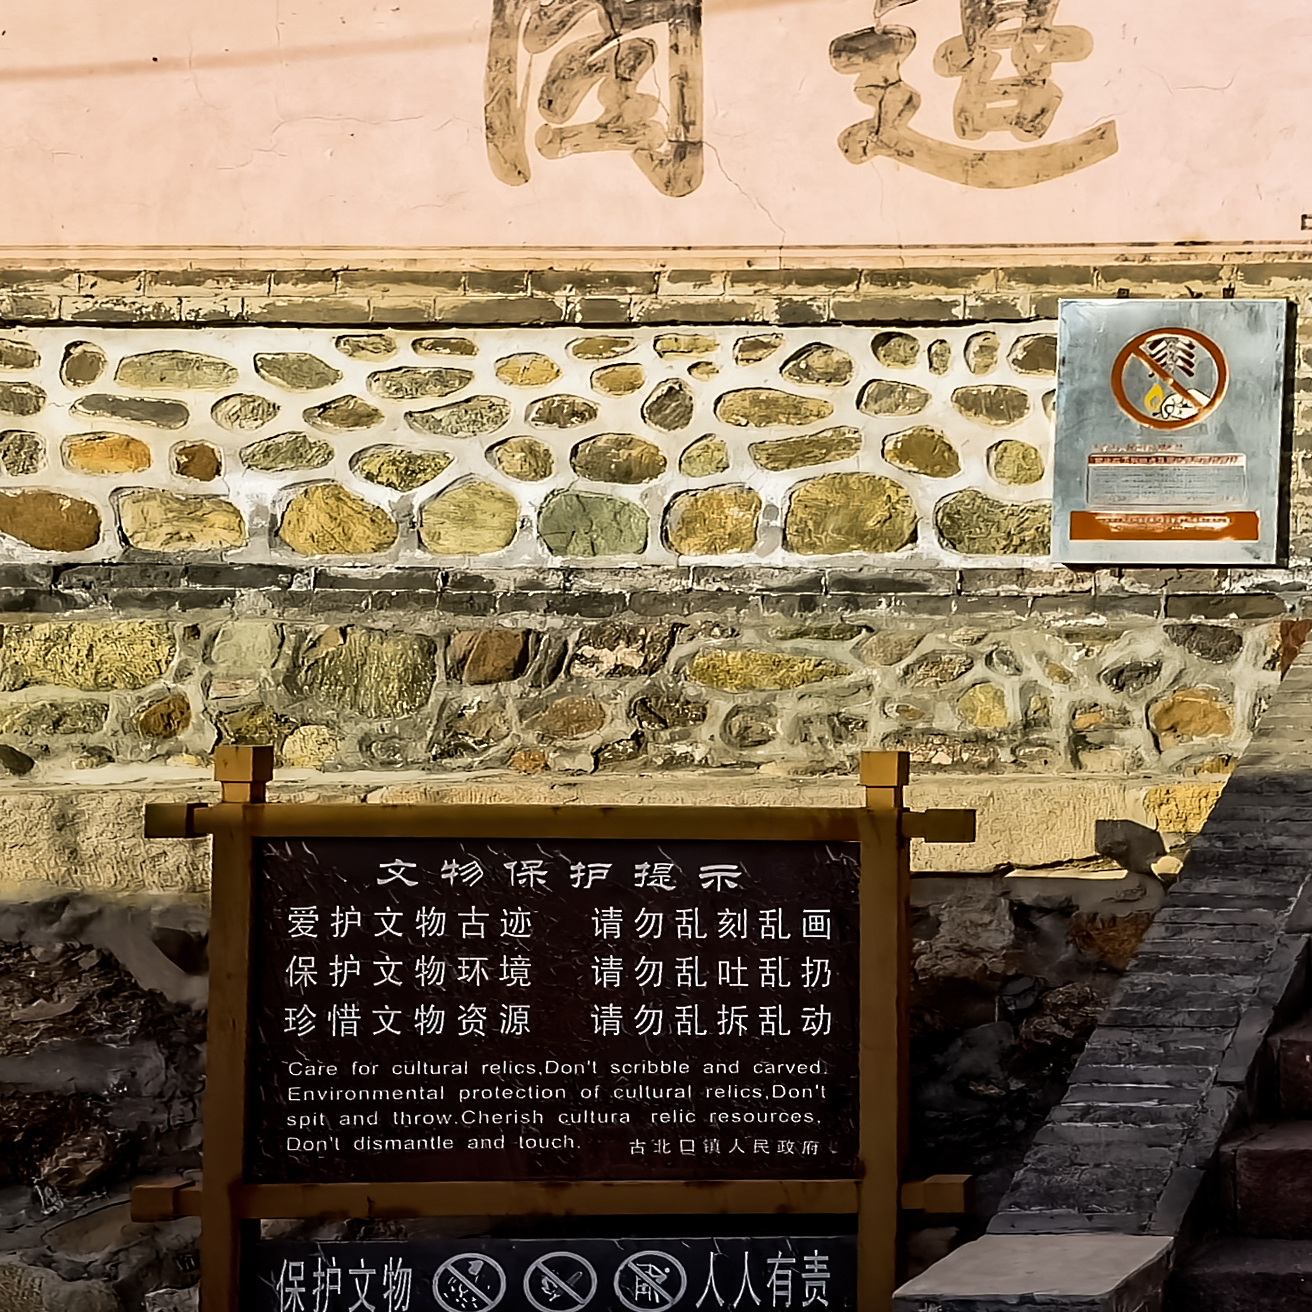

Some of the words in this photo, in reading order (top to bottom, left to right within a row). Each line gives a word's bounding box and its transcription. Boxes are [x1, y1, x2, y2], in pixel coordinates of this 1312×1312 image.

[377, 858, 742, 892] 文物保护提示
[287, 905, 532, 939] 爱护文物古迹
[591, 906, 832, 939] 请勿乱刻乱画
[285, 954, 532, 987] 保护文物环境
[591, 954, 832, 988] 请勿乱吐乱扔
[283, 1003, 531, 1037] 珍惜文物资源
[591, 1003, 832, 1036] 请勿乱拆乱动
[288, 1061, 338, 1076] Care
[352, 1061, 379, 1076] for
[392, 1061, 468, 1076] cultural
[610, 1060, 690, 1075] scribble
[703, 1060, 740, 1075] and
[288, 1086, 445, 1101] Environmental
[459, 1085, 566, 1103] protection
[580, 1084, 600, 1099] of
[613, 1084, 692, 1099] cultural
[287, 1111, 326, 1129] spit
[339, 1111, 378, 1125] and
[651, 1109, 697, 1124] relic
[287, 1136, 340, 1151] Don't
[353, 1136, 454, 1151] dismantle
[467, 1135, 505, 1150] and
[629, 1138, 819, 1156] 古北口镇人民政府
[277, 1255, 413, 1312] 保护文物
[696, 1250, 831, 1309] 人人有责
